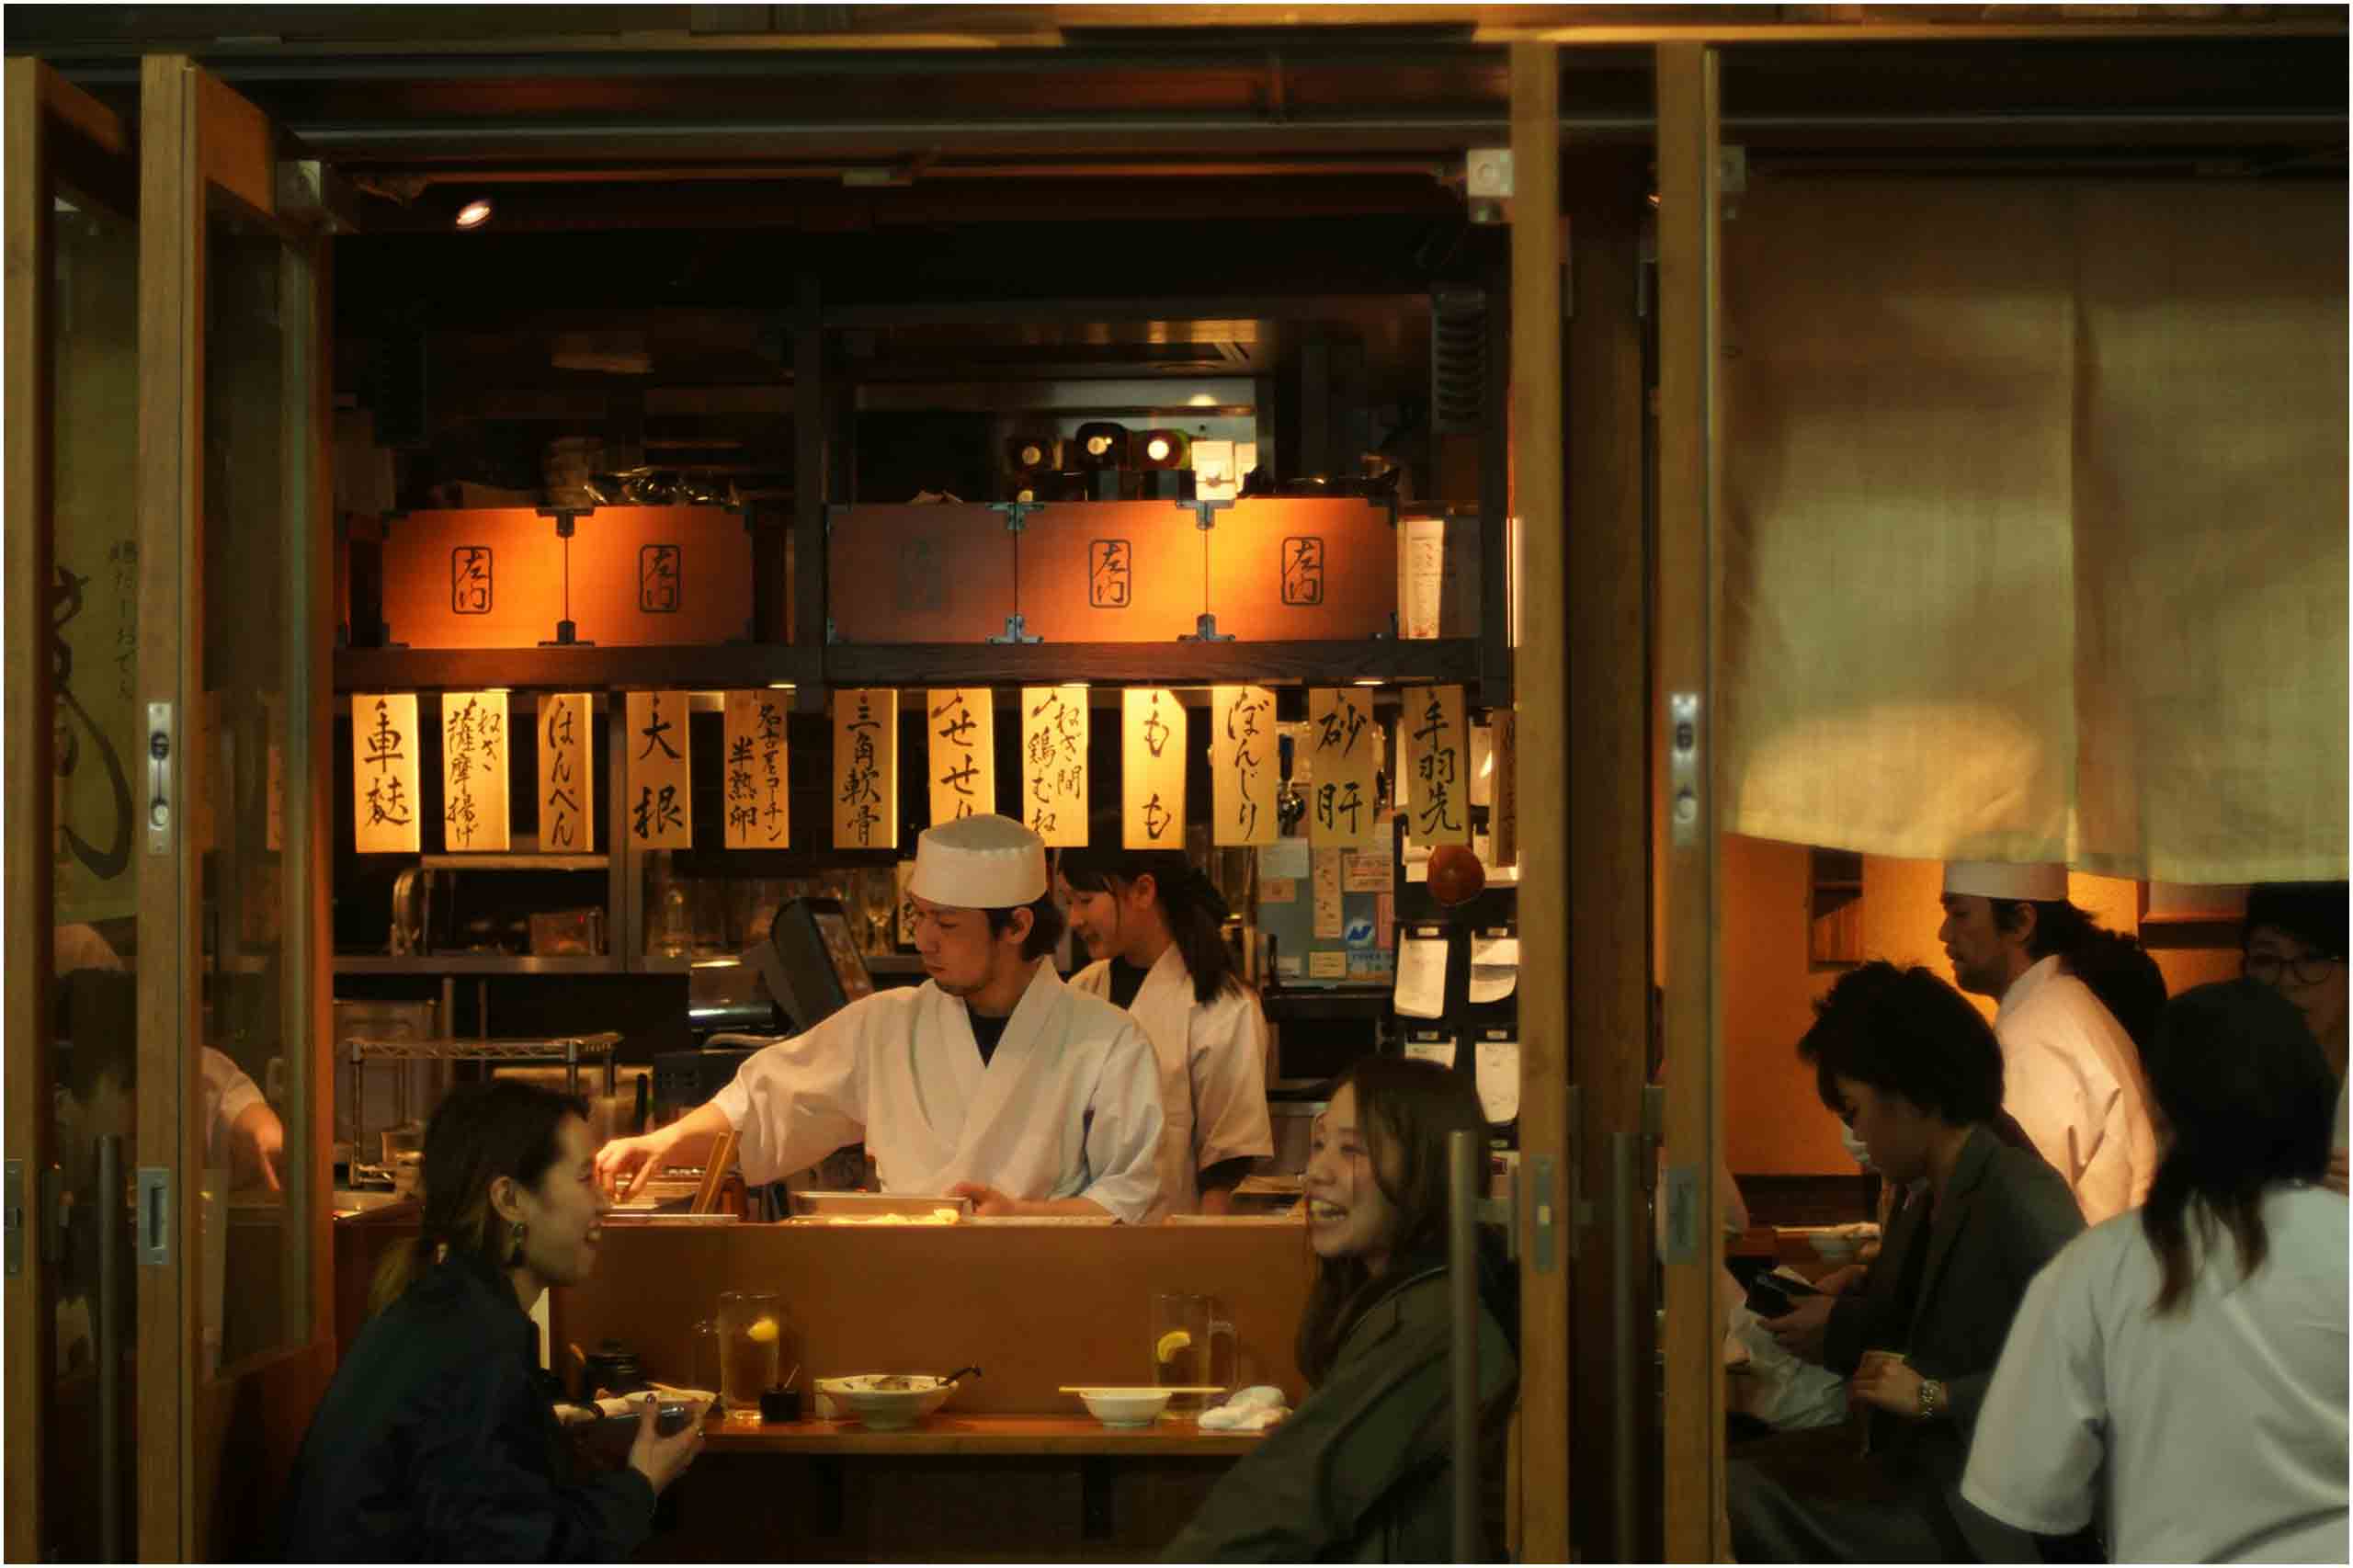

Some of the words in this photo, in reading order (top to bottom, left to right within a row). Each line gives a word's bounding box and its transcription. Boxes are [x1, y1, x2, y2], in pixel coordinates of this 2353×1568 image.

[447, 707, 478, 847] 薩摩揚げ
[477, 709, 501, 772] ねぎ
[548, 700, 579, 846] はんぺん
[633, 711, 682, 841] 大根
[729, 734, 758, 845] 半熟卵
[757, 703, 783, 842] 名古屋コーチン
[840, 705, 881, 846] 三角軟骨
[1029, 725, 1058, 835] 鶏むね
[1054, 703, 1083, 801] ねぎ間
[1140, 710, 1172, 840] もも
[1228, 699, 1270, 842] ぼんじり
[1316, 703, 1368, 835] 砂肝
[1413, 700, 1462, 836] 手羽先
